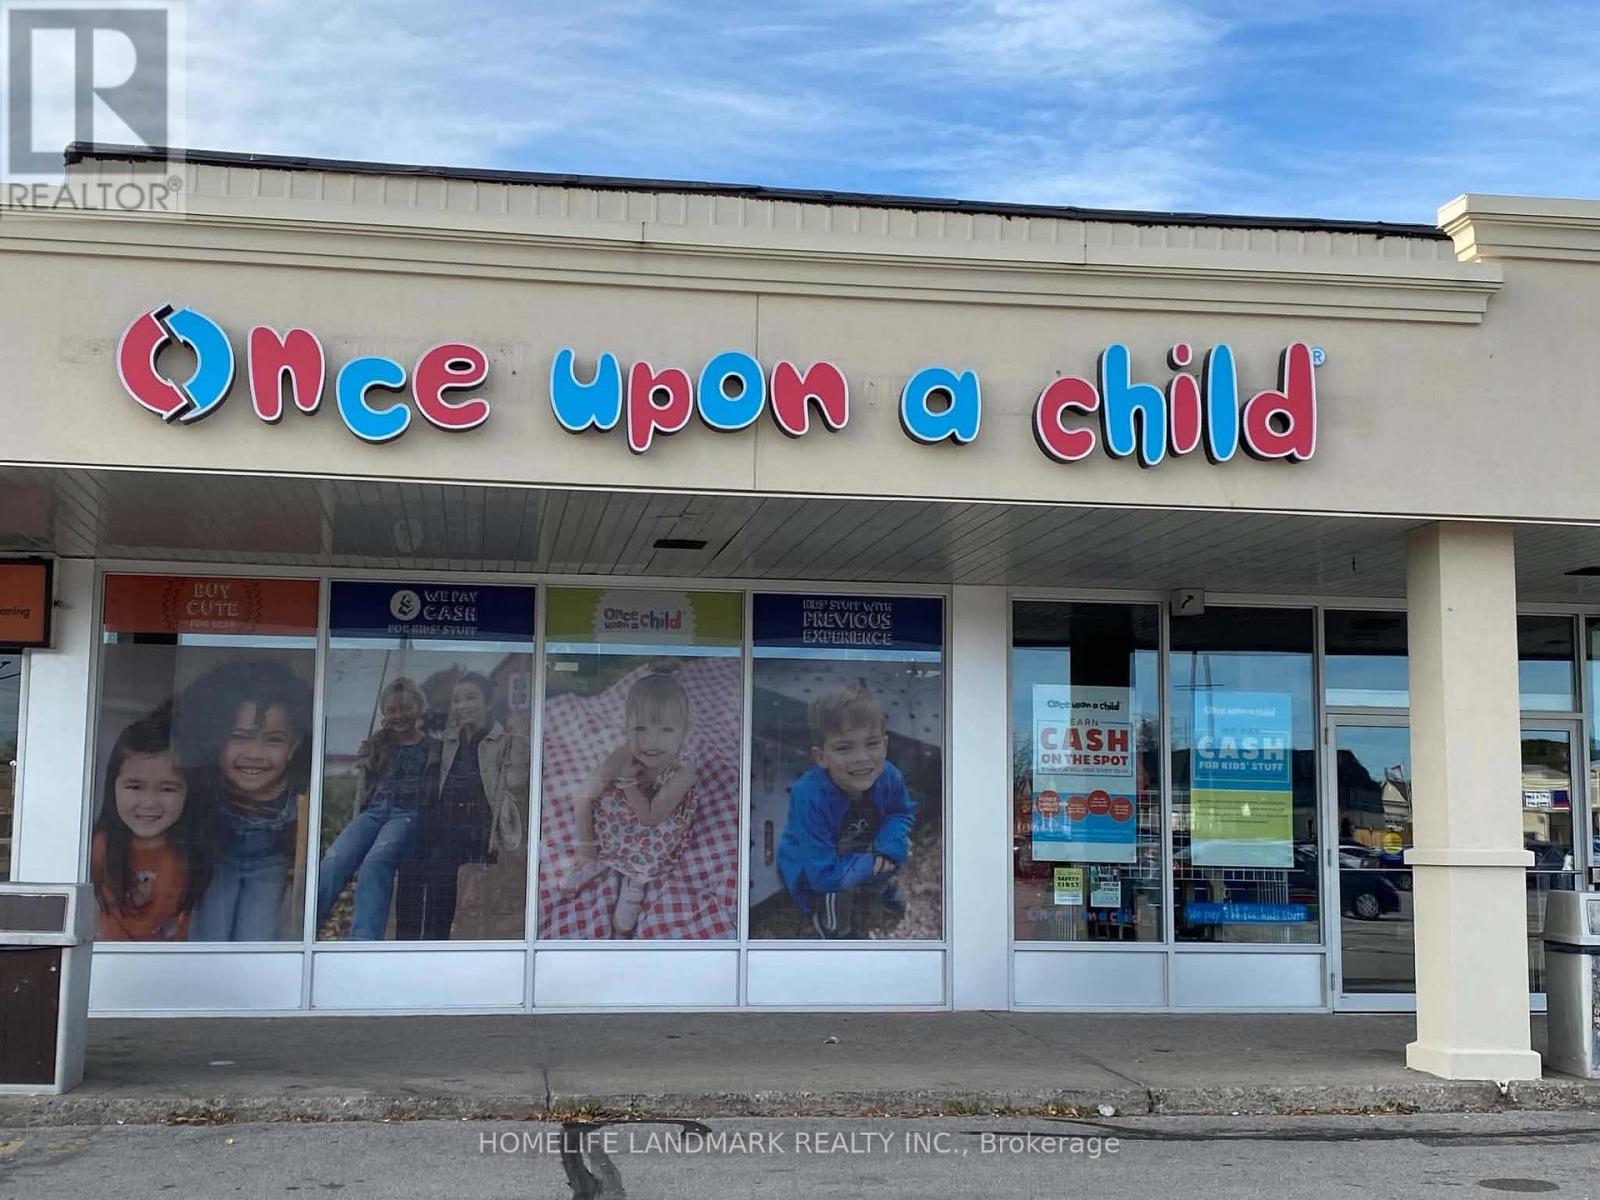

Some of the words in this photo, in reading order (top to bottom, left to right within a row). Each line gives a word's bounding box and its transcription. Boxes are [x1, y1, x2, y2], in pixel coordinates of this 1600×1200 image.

[116, 303, 490, 444] Once
[549, 347, 849, 455] upon
[899, 365, 982, 446] a
[424, 590, 449, 602] WE
[451, 591, 478, 603] PAY
[186, 601, 239, 617] CUTE
[423, 606, 479, 622] CASH
[802, 611, 893, 629] PREVIOUS
[802, 629, 893, 646] EXPERIENCE
[1071, 718, 1099, 727] EARN
[1040, 727, 1129, 752] CASH
[1198, 736, 1284, 760] CASH
[1041, 754, 1061, 764] ON
[1063, 754, 1090, 765] THE
[1093, 755, 1129, 766] SPOT
[1199, 761, 1219, 770] FOR
[1251, 763, 1285, 772] STUFF
